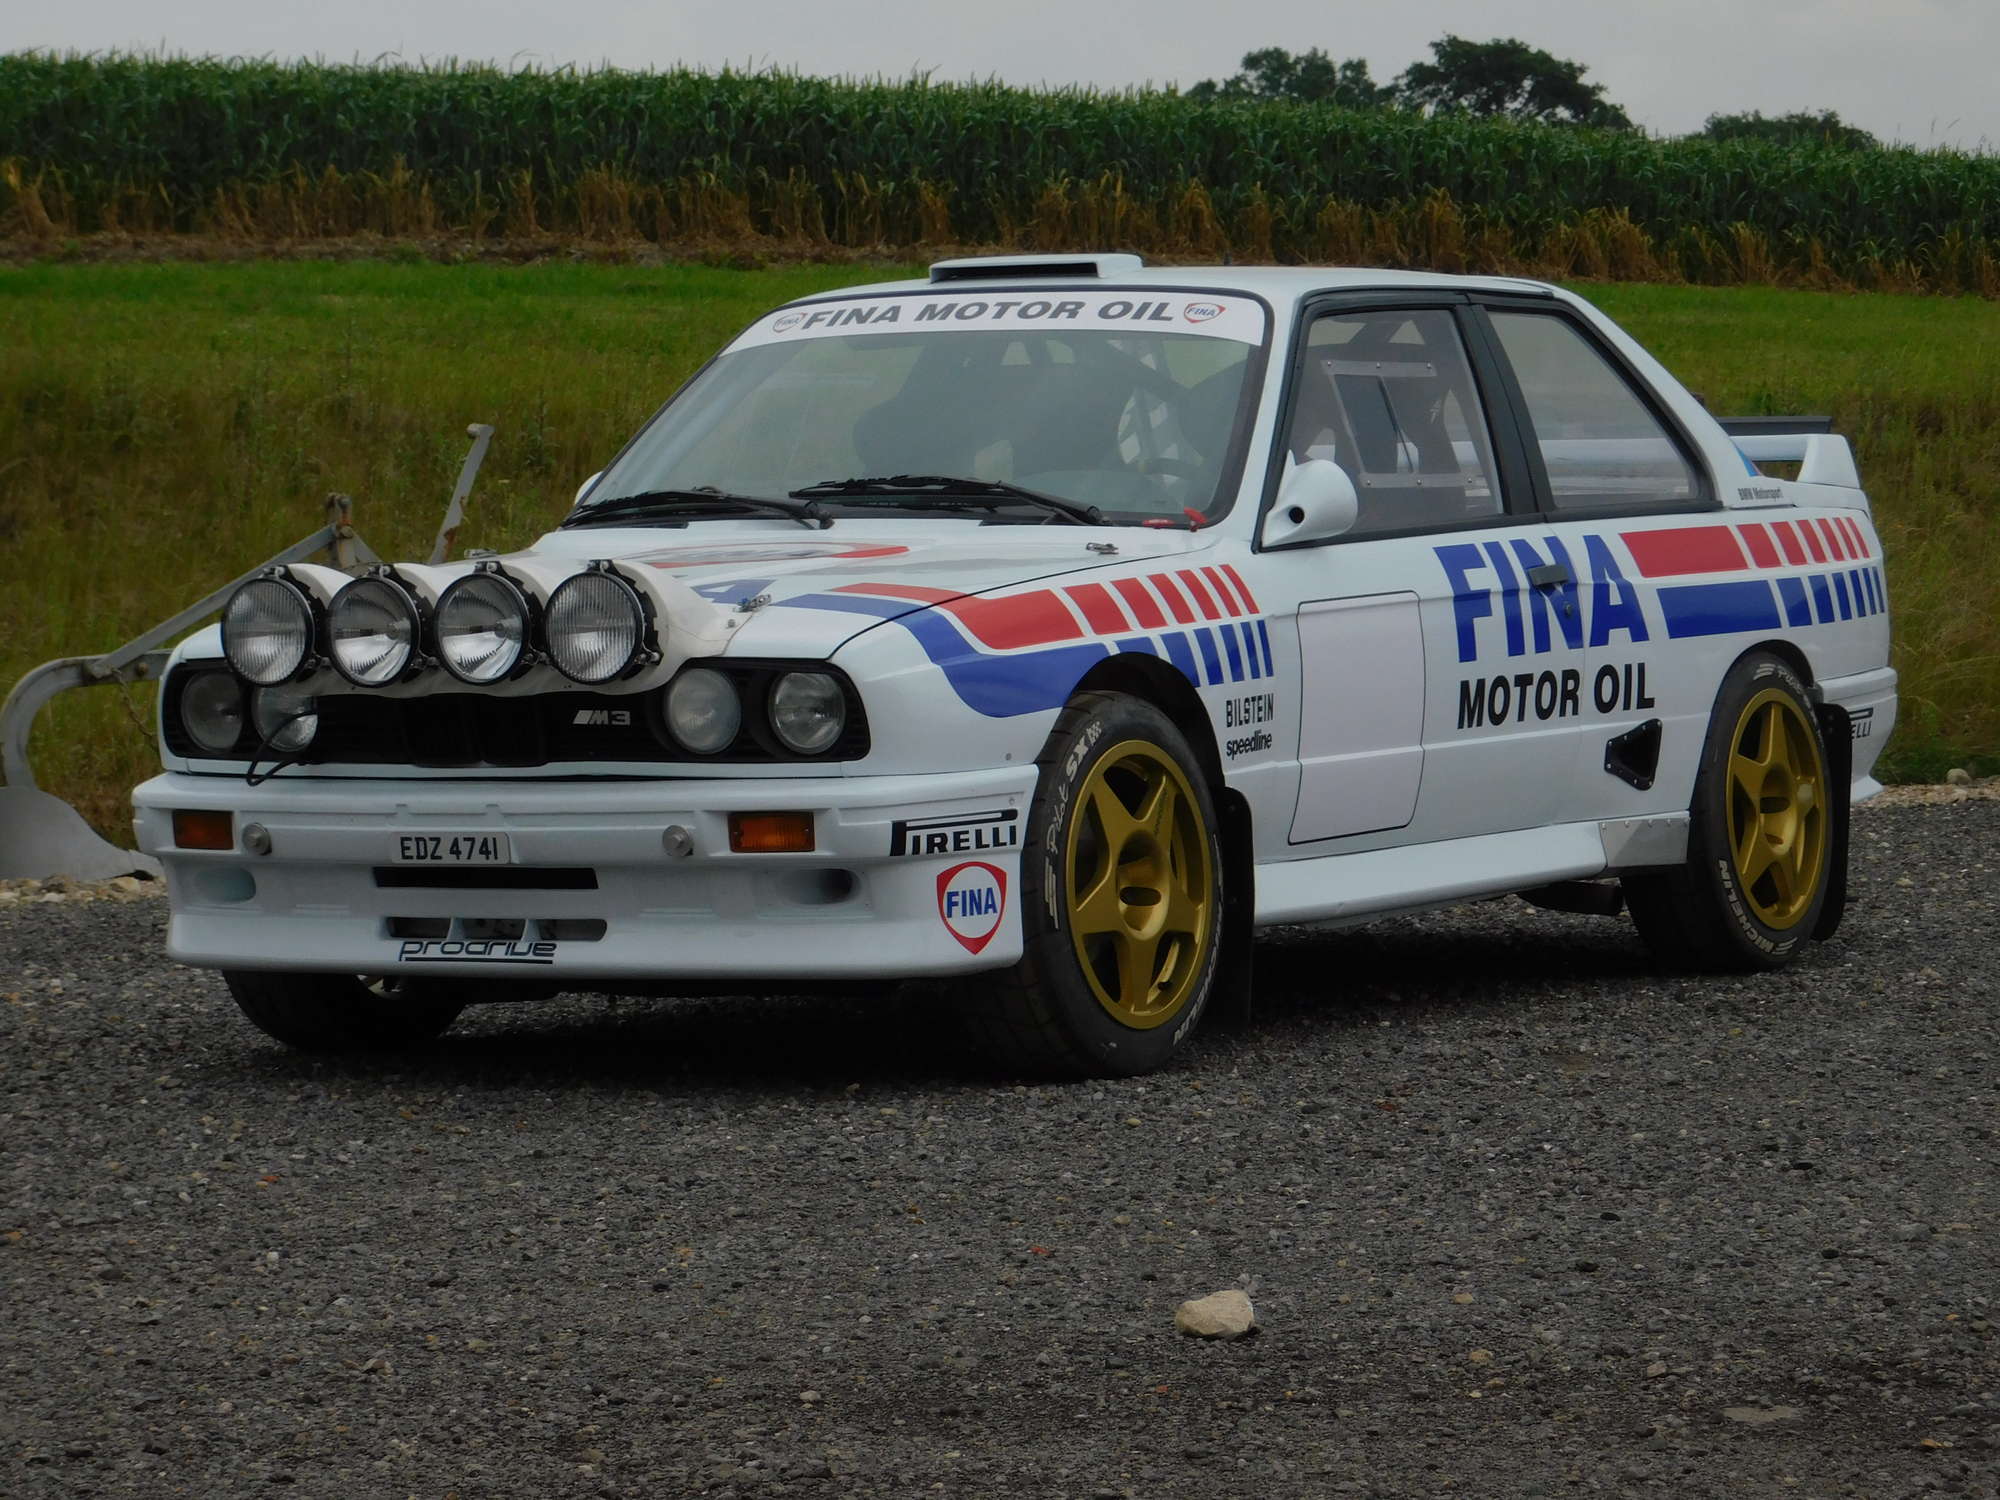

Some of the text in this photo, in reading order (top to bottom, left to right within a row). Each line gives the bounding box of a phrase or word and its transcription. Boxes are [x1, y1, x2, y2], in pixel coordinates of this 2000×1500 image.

[802, 301, 1174, 330] FINA MOTOR OIL
[1187, 307, 1216, 317] FINA
[1432, 534, 1650, 663] FINA
[1226, 692, 1274, 728] BILSTEIN
[1457, 662, 1656, 730] MOTOR OIL
[583, 709, 631, 726] M3
[1226, 729, 1273, 760] speedline
[400, 837, 499, 860] EDZ 4741
[890, 809, 1018, 857] PIRELLI
[946, 887, 998, 918] FINA
[1719, 859, 1775, 953] MICHELIN
[399, 941, 557, 962] prodrive
